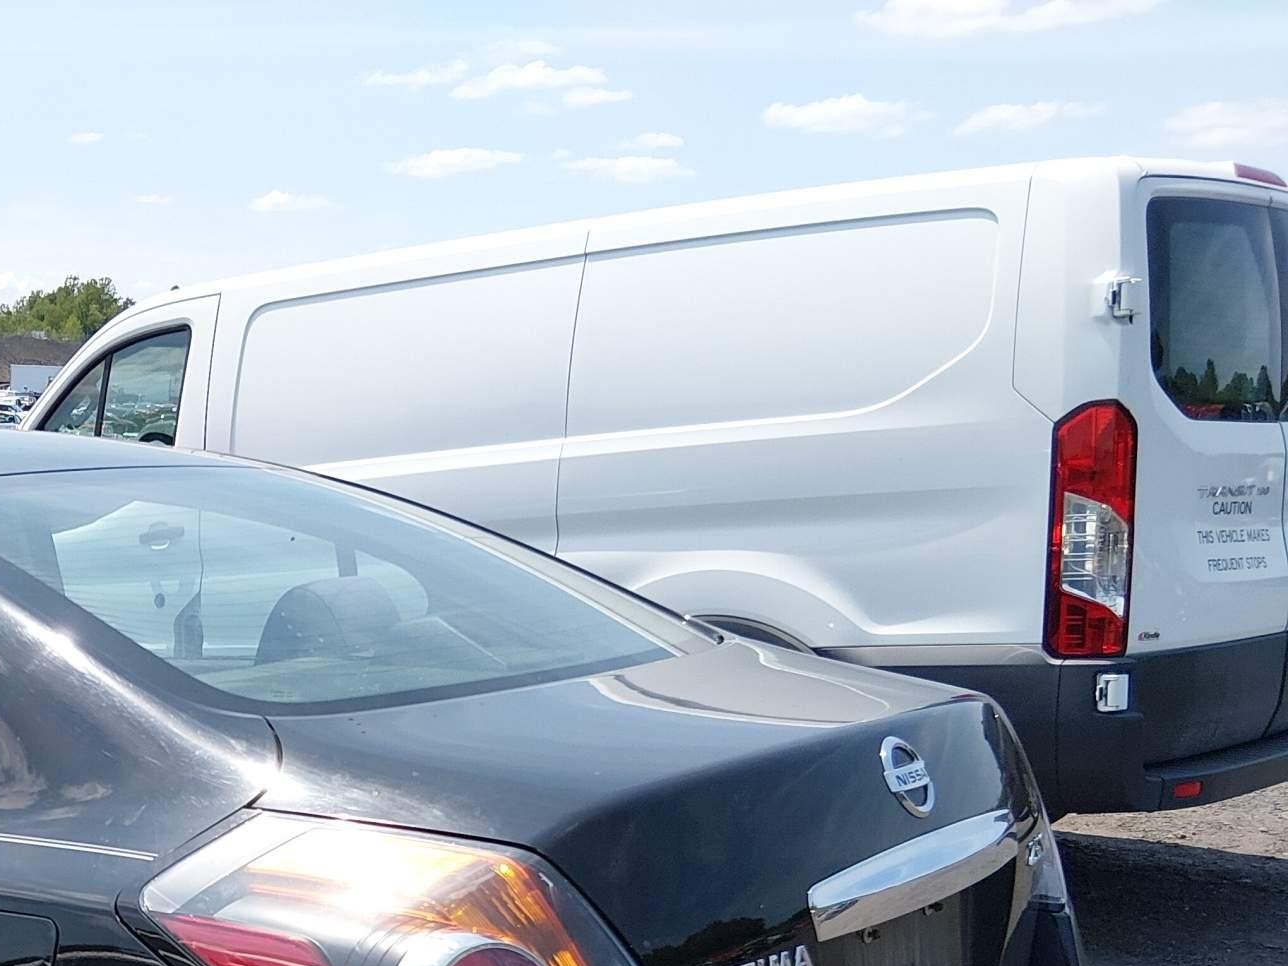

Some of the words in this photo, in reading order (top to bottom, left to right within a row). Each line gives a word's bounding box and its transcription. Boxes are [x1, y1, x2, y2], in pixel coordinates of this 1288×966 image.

[1212, 501, 1252, 515] CAUTION
[1197, 530, 1214, 544] THIS
[1216, 529, 1245, 543] VEHICLE
[1247, 528, 1270, 542] MAKES
